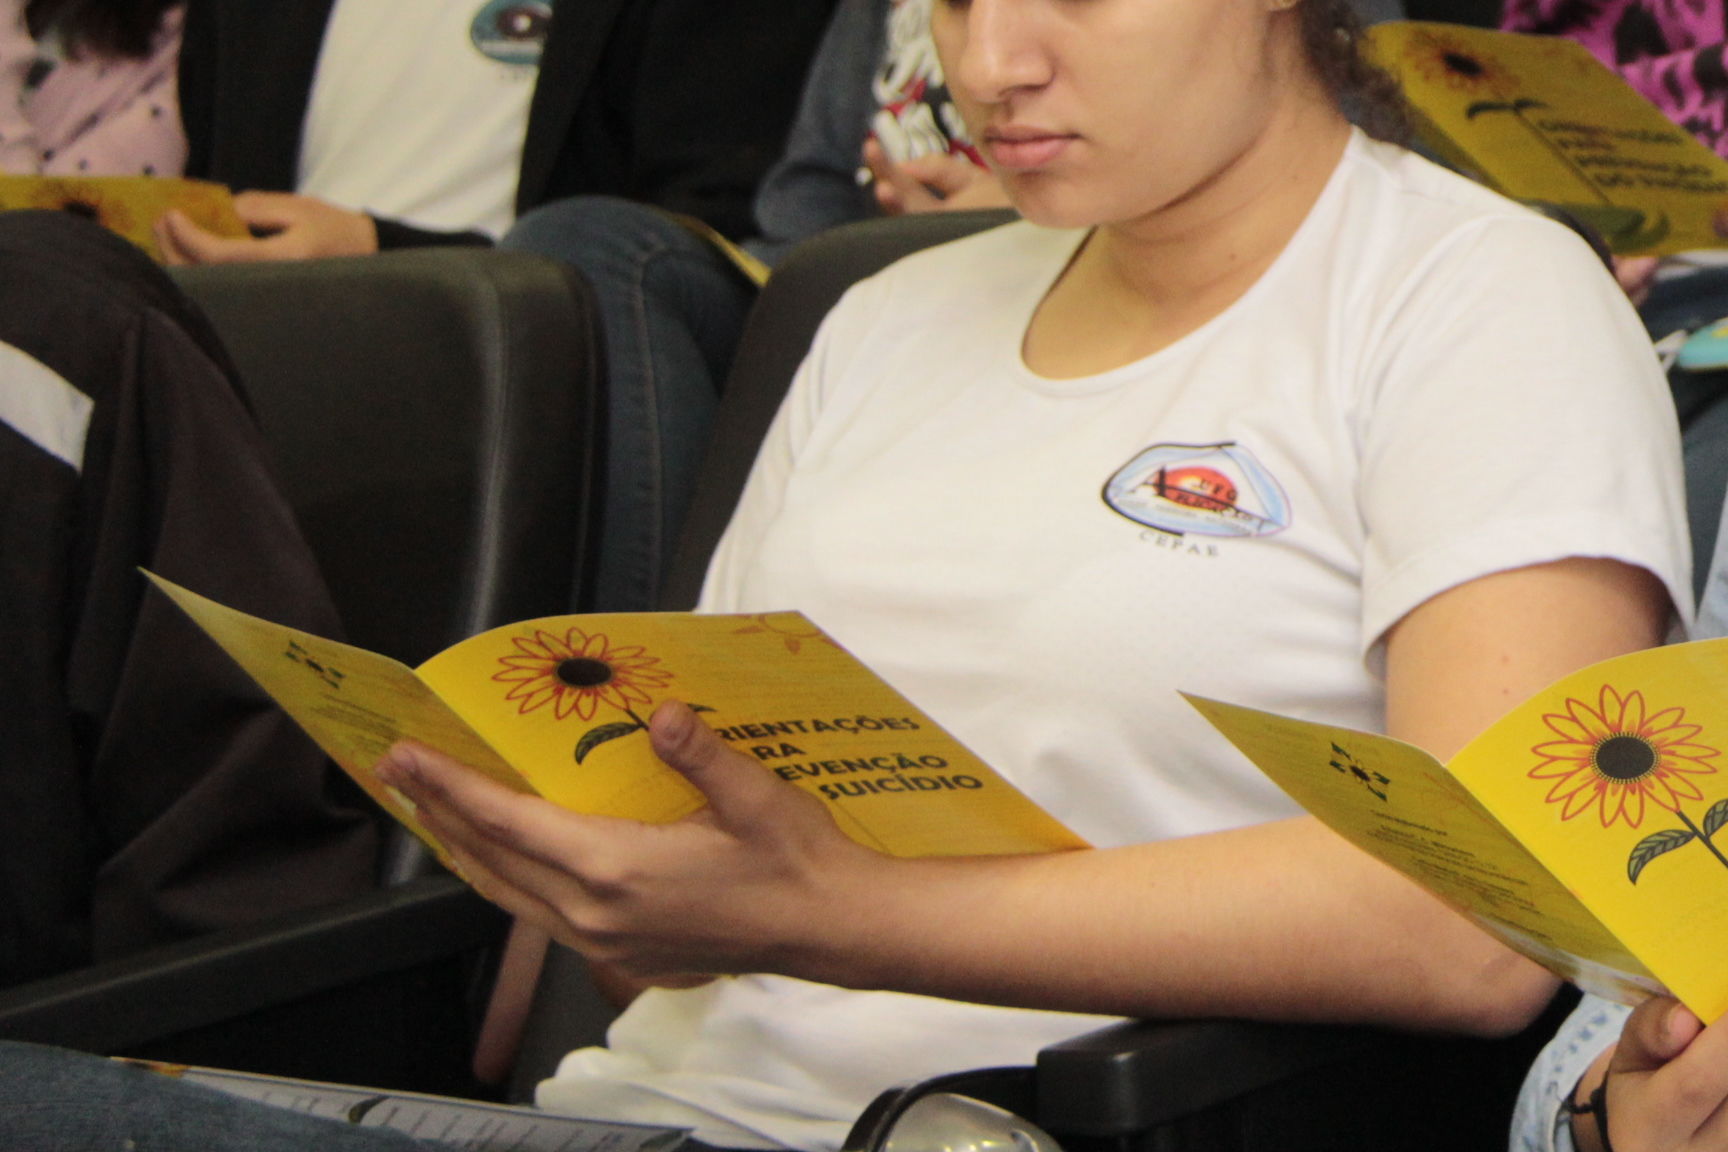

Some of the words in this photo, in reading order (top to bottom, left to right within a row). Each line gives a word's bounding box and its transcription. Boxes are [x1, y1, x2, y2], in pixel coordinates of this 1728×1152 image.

[714, 715, 920, 742] RIENTAÇÕES
[751, 742, 806, 760] RA
[773, 752, 949, 782] EVENÇÃO
[819, 774, 984, 800] SUICÍDIO
